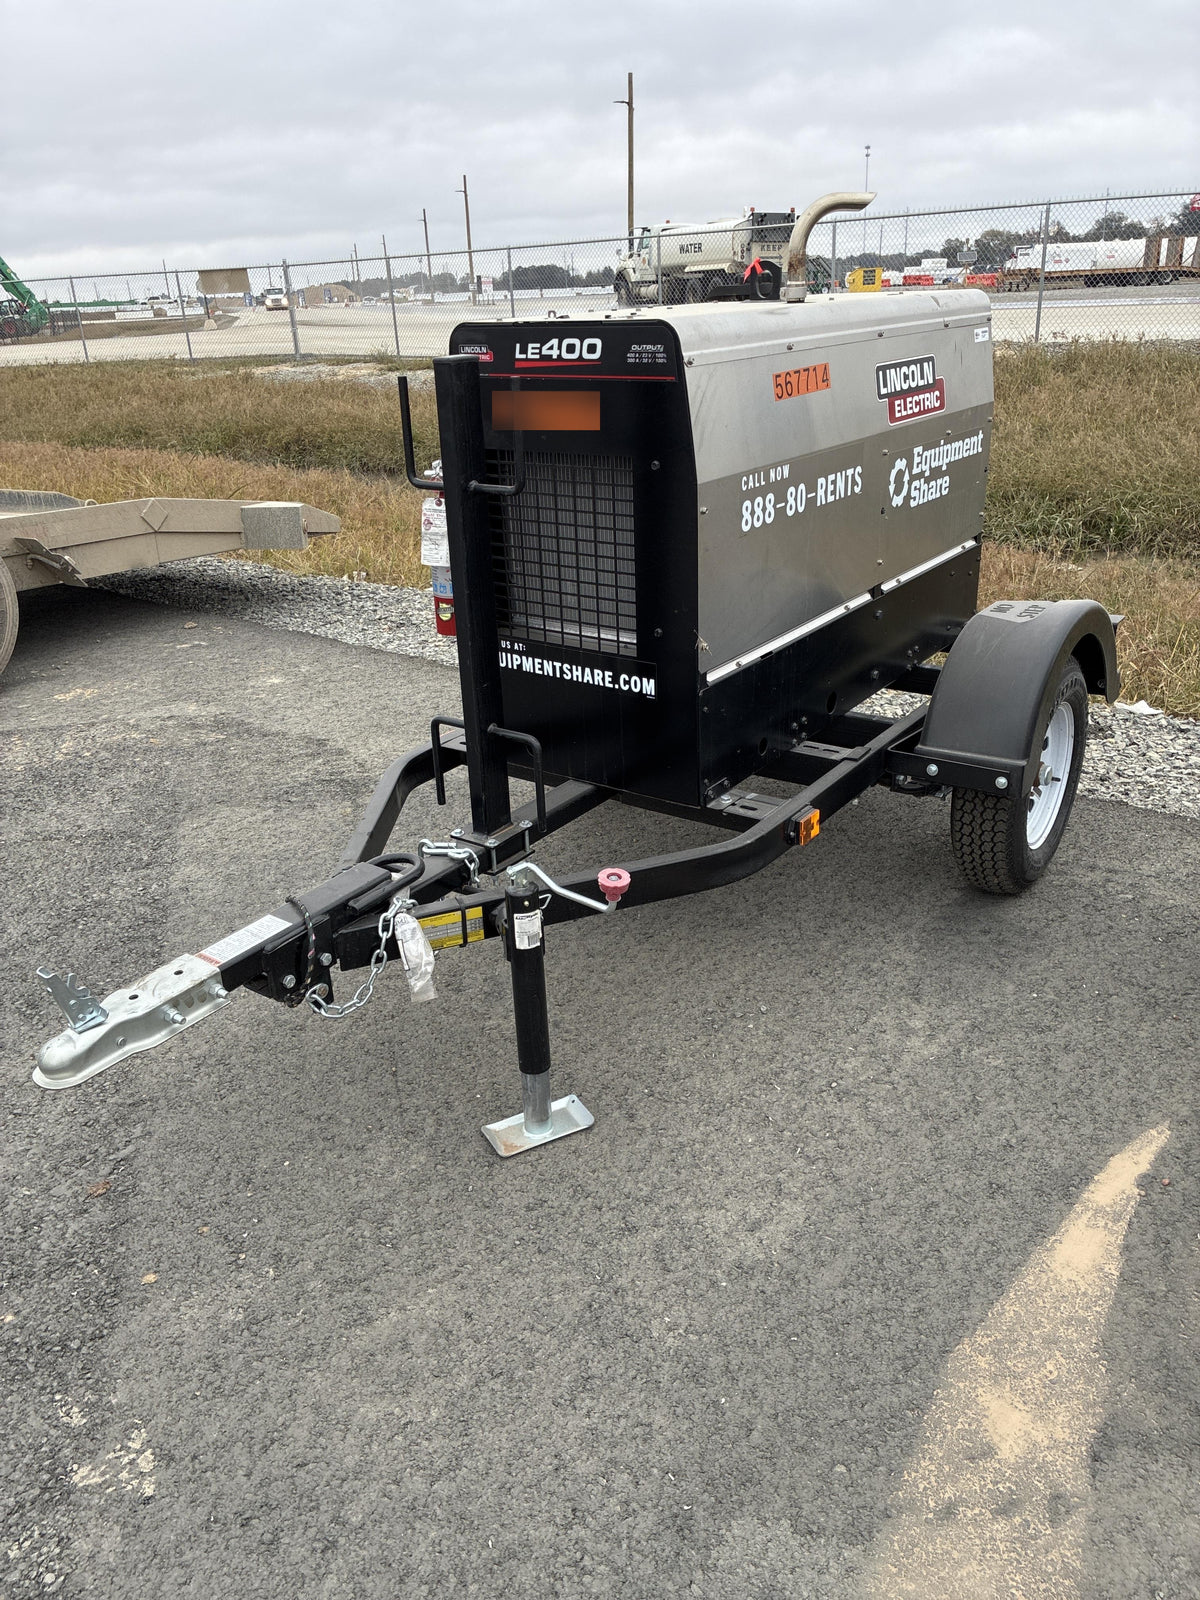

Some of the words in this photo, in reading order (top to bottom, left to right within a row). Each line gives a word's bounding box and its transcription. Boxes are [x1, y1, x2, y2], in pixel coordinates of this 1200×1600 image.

[679, 242, 703, 255] WATER
[515, 337, 603, 359] LE400
[774, 364, 830, 400] 567714
[878, 361, 934, 395] LINCOLN
[894, 390, 941, 418] ELECTRIC
[912, 429, 984, 477] Equipment
[741, 471, 766, 491] CALL
[769, 464, 790, 483] NOW
[741, 465, 863, 532] 888-80-RENTS
[910, 475, 950, 508] Share
[989, 603, 1015, 613] NO
[1016, 604, 1047, 618] STEP
[500, 639, 511, 649] US
[514, 642, 526, 651] AT:
